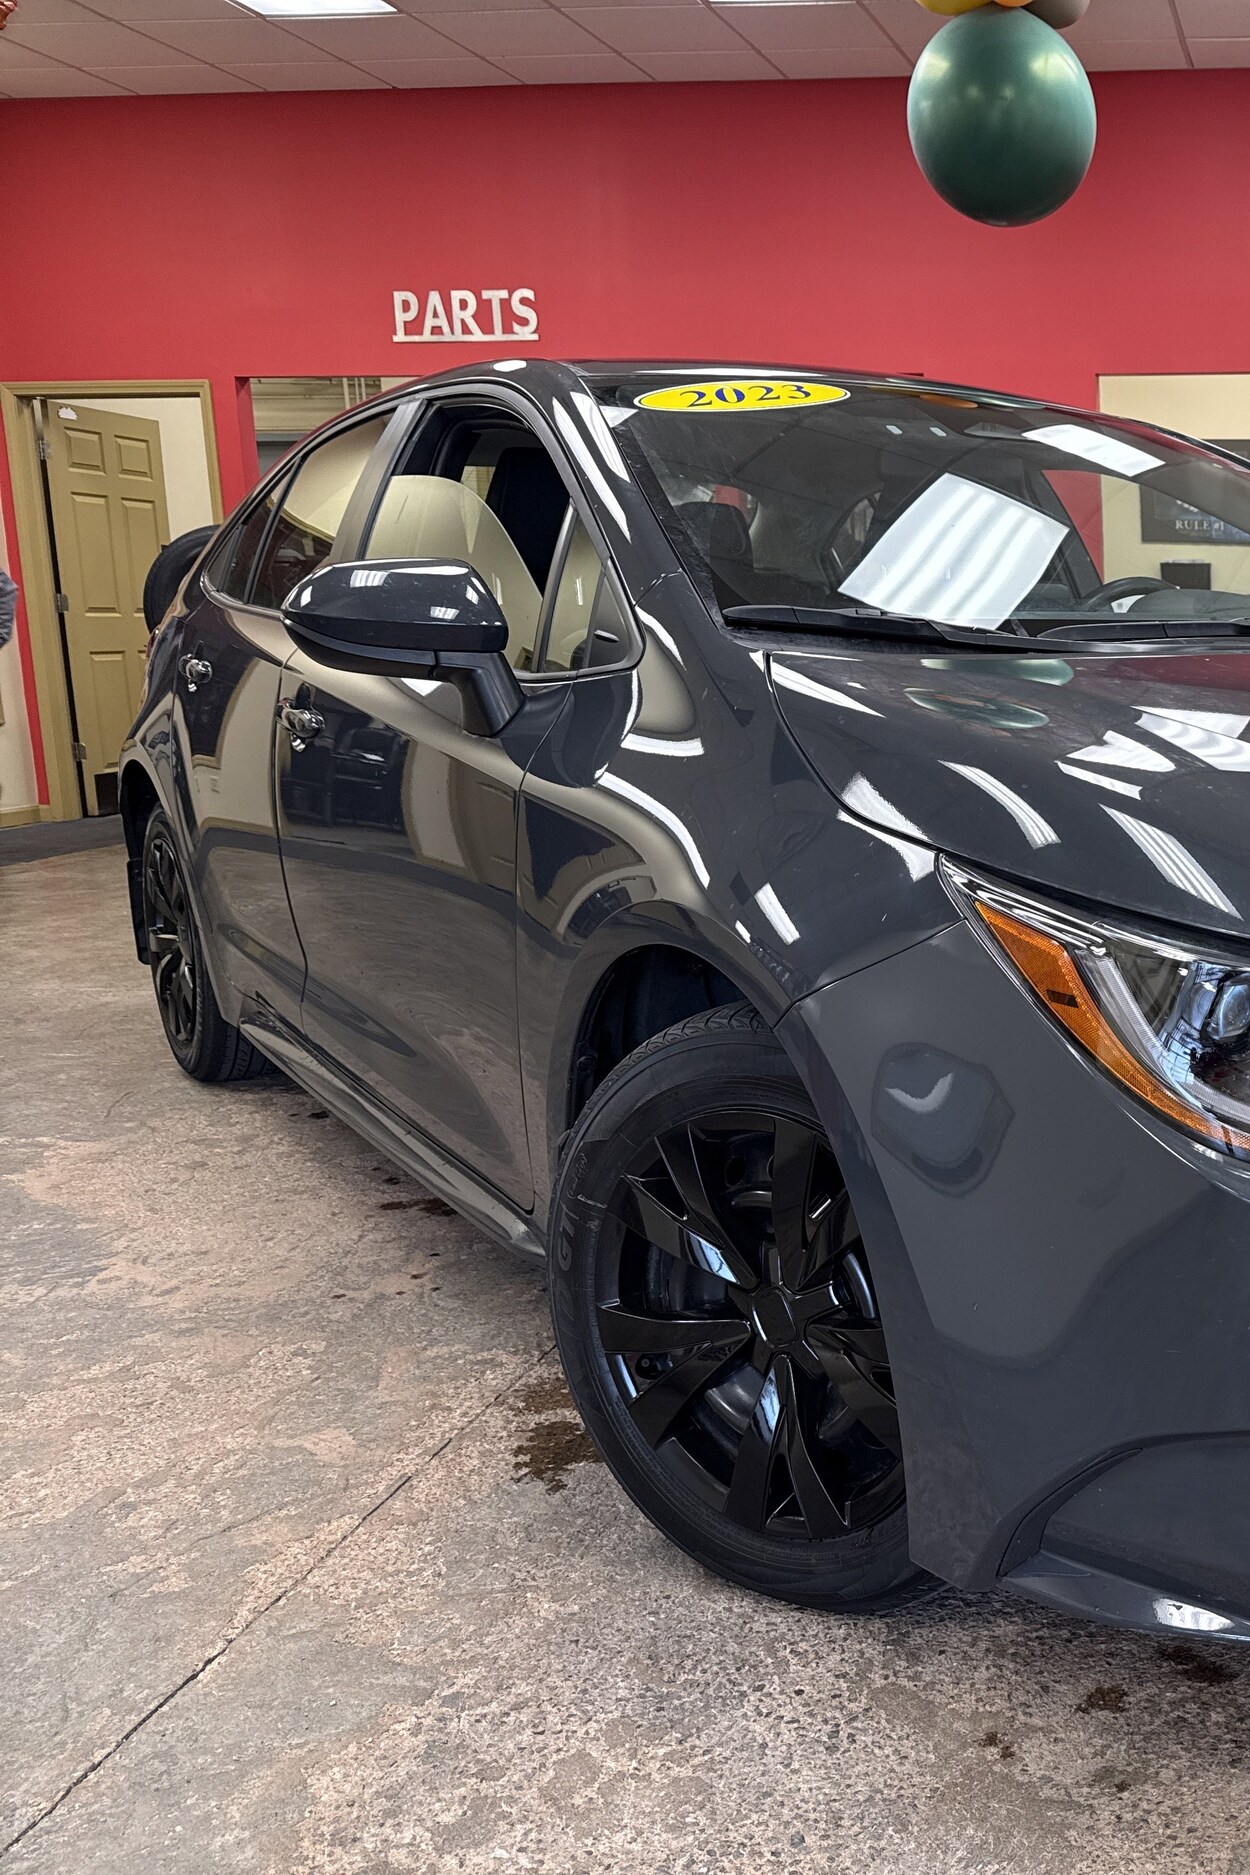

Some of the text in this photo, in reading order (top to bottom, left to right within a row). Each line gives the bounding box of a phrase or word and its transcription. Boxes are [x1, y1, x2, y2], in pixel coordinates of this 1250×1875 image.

[393, 288, 538, 337] PARTS
[679, 384, 812, 408] 2023
[1175, 520, 1210, 530] RULE
